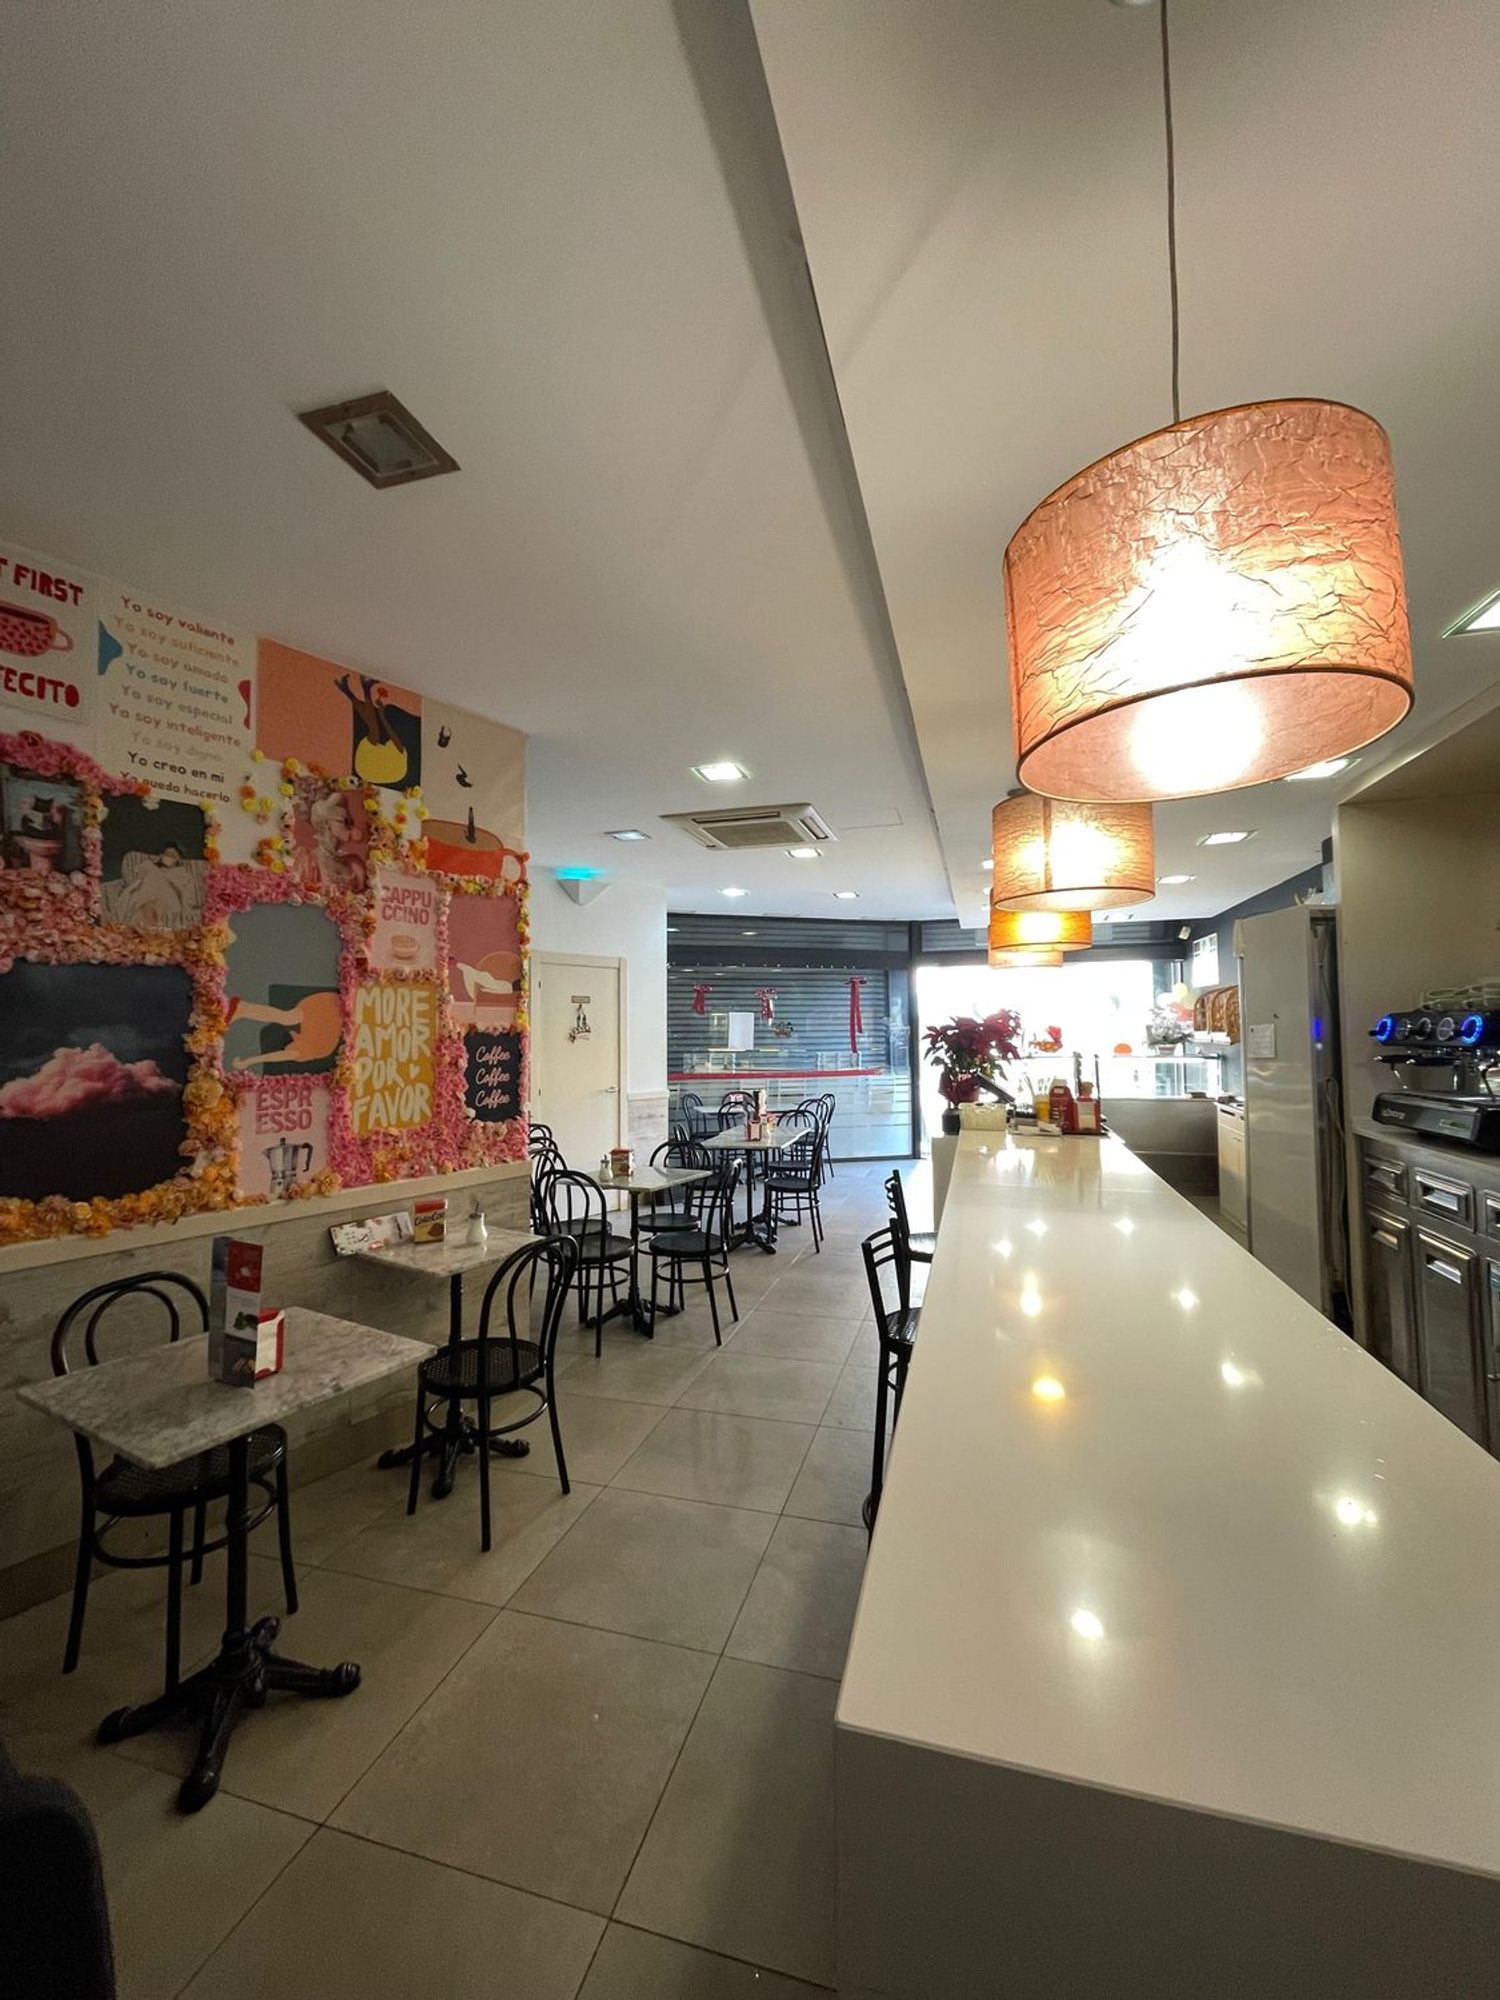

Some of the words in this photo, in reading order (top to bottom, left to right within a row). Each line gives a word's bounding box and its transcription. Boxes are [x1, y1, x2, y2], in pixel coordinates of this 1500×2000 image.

[13, 563, 84, 606] FIRST
[113, 613, 135, 633] Yo
[140, 628, 166, 645] soy
[170, 637, 239, 667] suficiente
[121, 595, 142, 613] Yo
[147, 608, 173, 626] soy
[178, 618, 235, 645] valiente
[127, 641, 148, 658] Yo
[153, 653, 179, 669] soy
[126, 662, 146, 680] Yo
[151, 674, 177, 691] soy
[183, 681, 229, 704] fuerte
[121, 683, 142, 700] Yo
[147, 694, 172, 710] soy
[178, 703, 233, 725] especial
[109, 702, 130, 719] Yo
[135, 712, 161, 729] soy
[166, 719, 241, 747] inteligente
[127, 750, 148, 766] Yo
[153, 760, 187, 775] creo
[190, 769, 208, 780] en
[210, 771, 225, 783] mi
[183, 784, 231, 803] hacerlo
[355, 986, 430, 1027] MORE
[355, 1022, 432, 1062] AMOR
[475, 1045, 511, 1065] Coffee
[353, 1056, 405, 1098] POR
[475, 1067, 511, 1087] Coffee
[256, 1085, 312, 1112] ESPR
[353, 1082, 433, 1134] FAVOR
[475, 1089, 511, 1109] Coffee
[256, 1109, 312, 1135] ESSO
